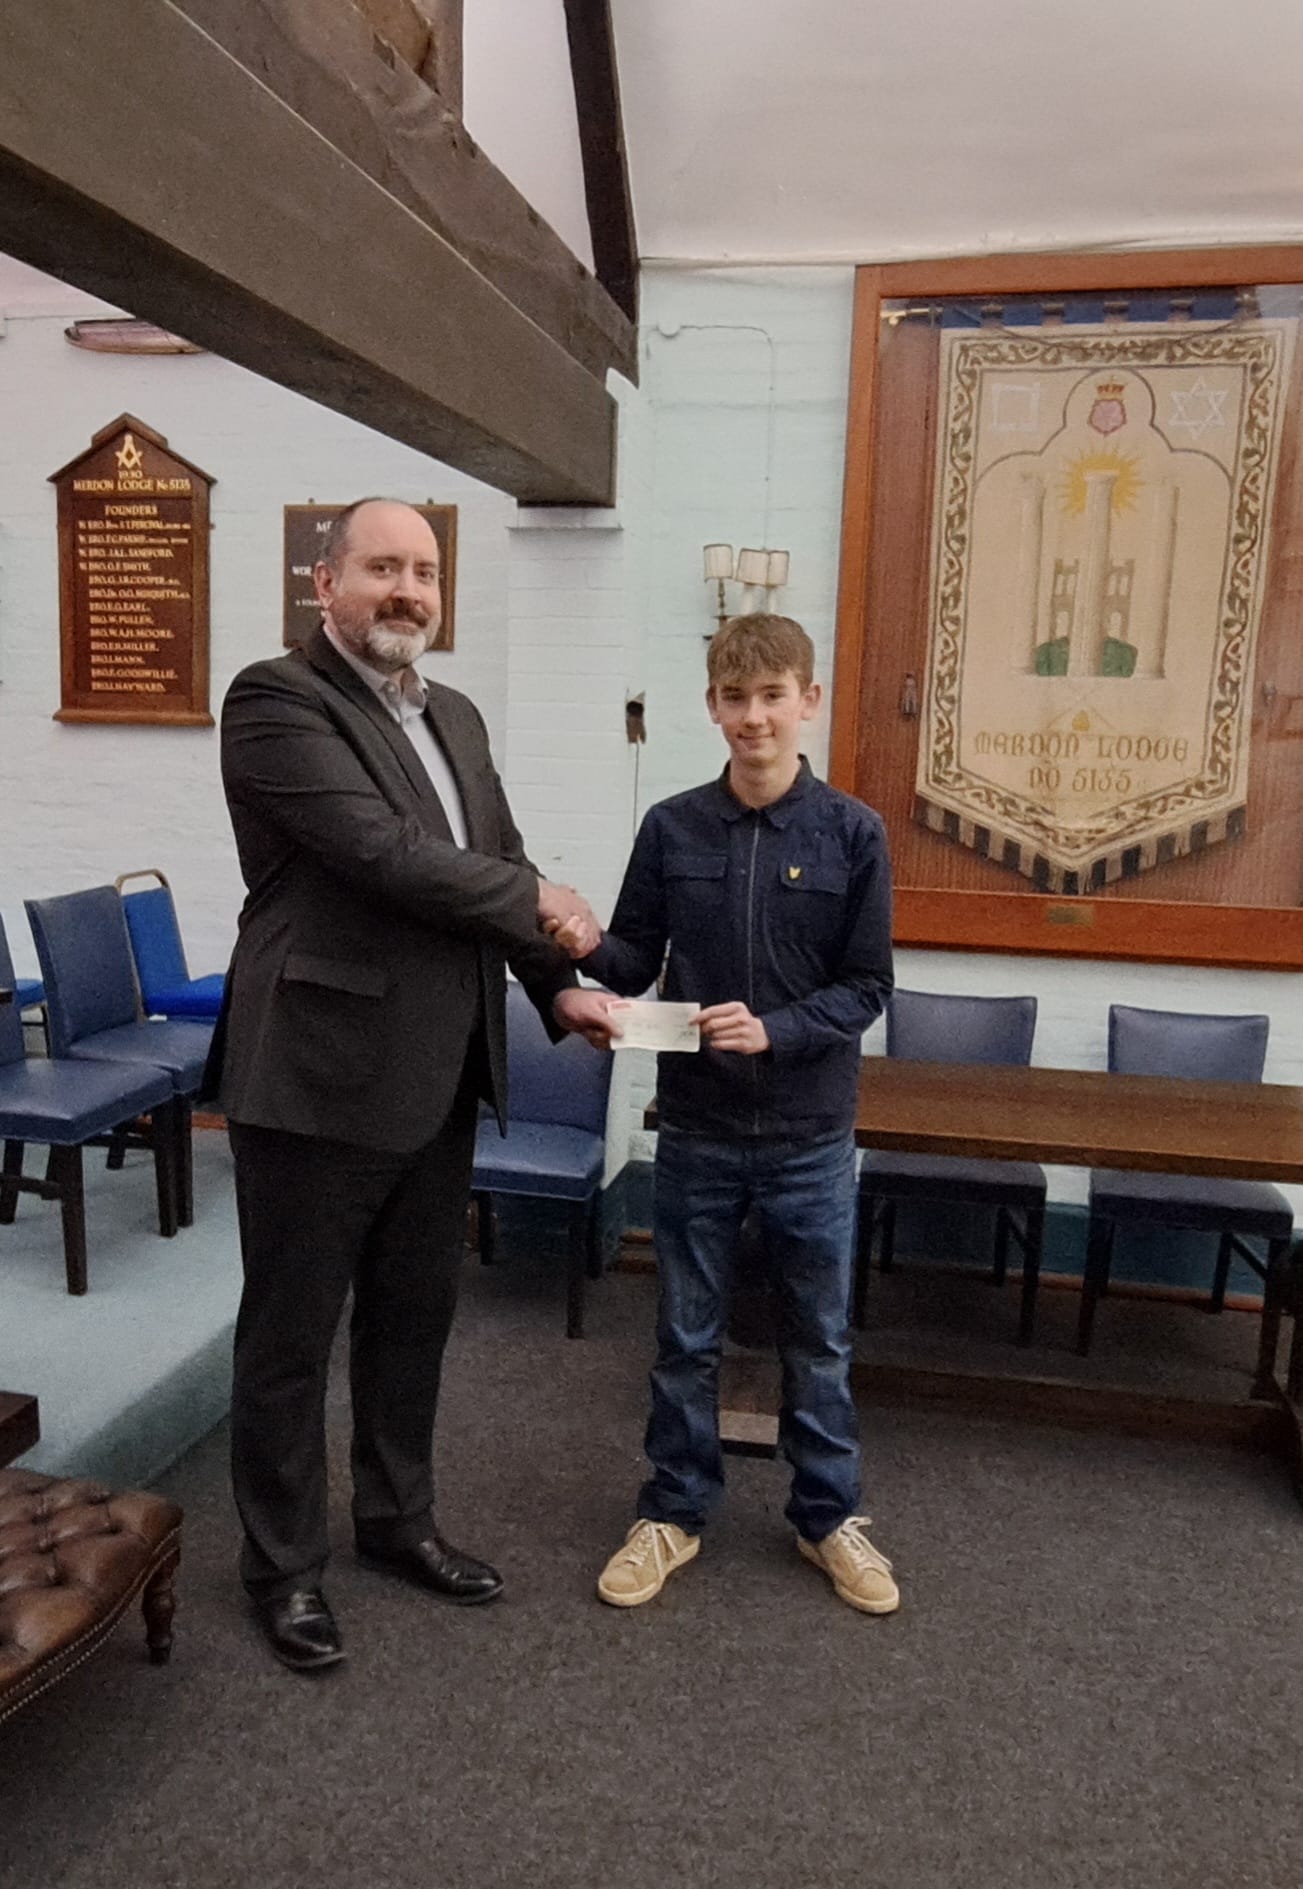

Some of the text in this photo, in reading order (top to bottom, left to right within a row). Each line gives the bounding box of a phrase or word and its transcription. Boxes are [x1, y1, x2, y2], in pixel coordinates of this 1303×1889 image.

[73, 480, 114, 491] MERDON
[117, 480, 154, 491] LODGE
[105, 505, 158, 515] FOUNDERS
[974, 731, 1189, 762] MERDON LODGE
[1072, 767, 1133, 794] 5135
